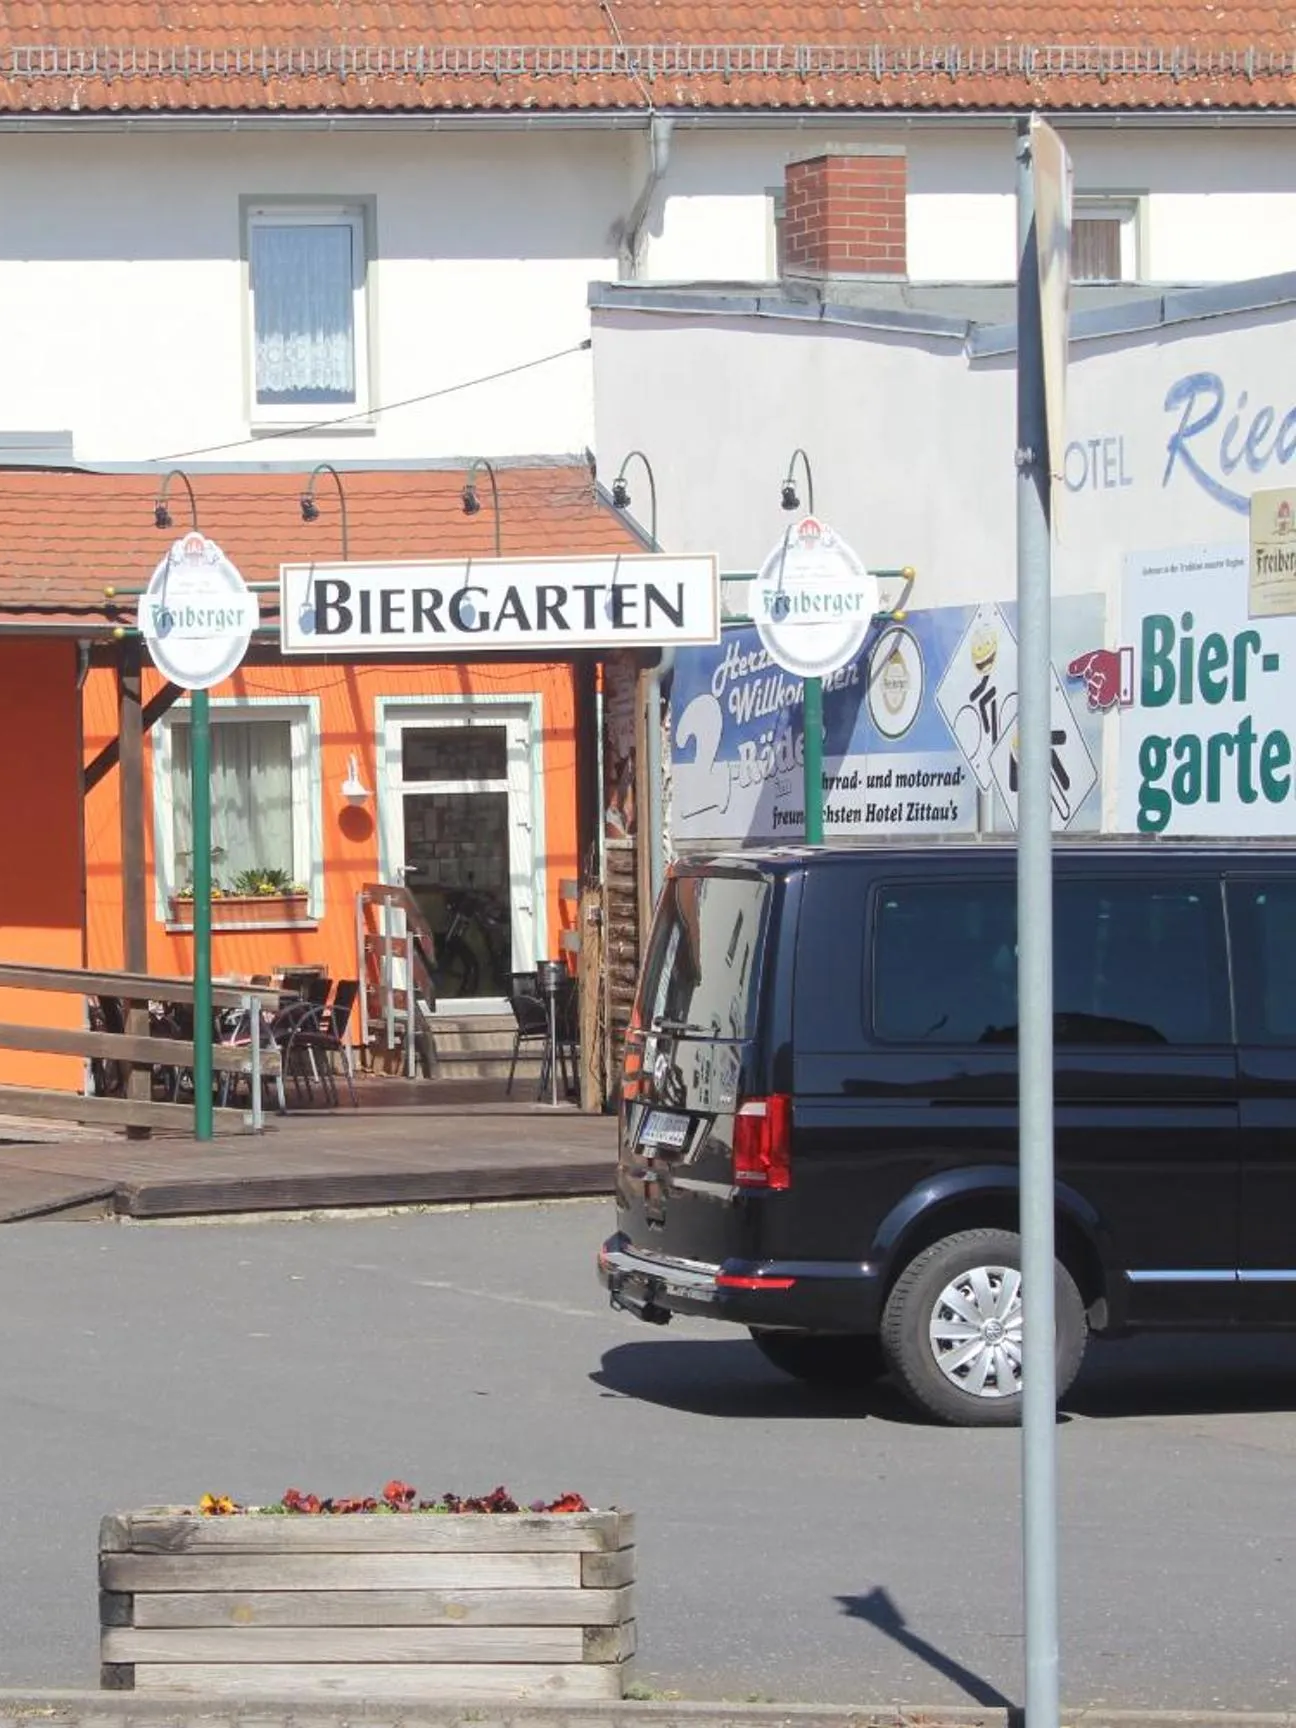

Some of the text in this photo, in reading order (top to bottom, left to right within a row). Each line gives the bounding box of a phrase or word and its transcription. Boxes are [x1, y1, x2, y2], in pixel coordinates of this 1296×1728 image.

[1065, 436, 1134, 492] OTEL
[1255, 547, 1296, 577] Freiber
[149, 604, 245, 632] Freiberger
[314, 579, 686, 635] BIERGARTEN
[762, 589, 864, 617] Freiberger
[1140, 611, 1280, 708] Bier-
[821, 766, 966, 790] hrrad- und motorrad-
[1137, 715, 1296, 833] garte
[865, 802, 903, 823] Hotel
[906, 799, 958, 822] Zittau's
